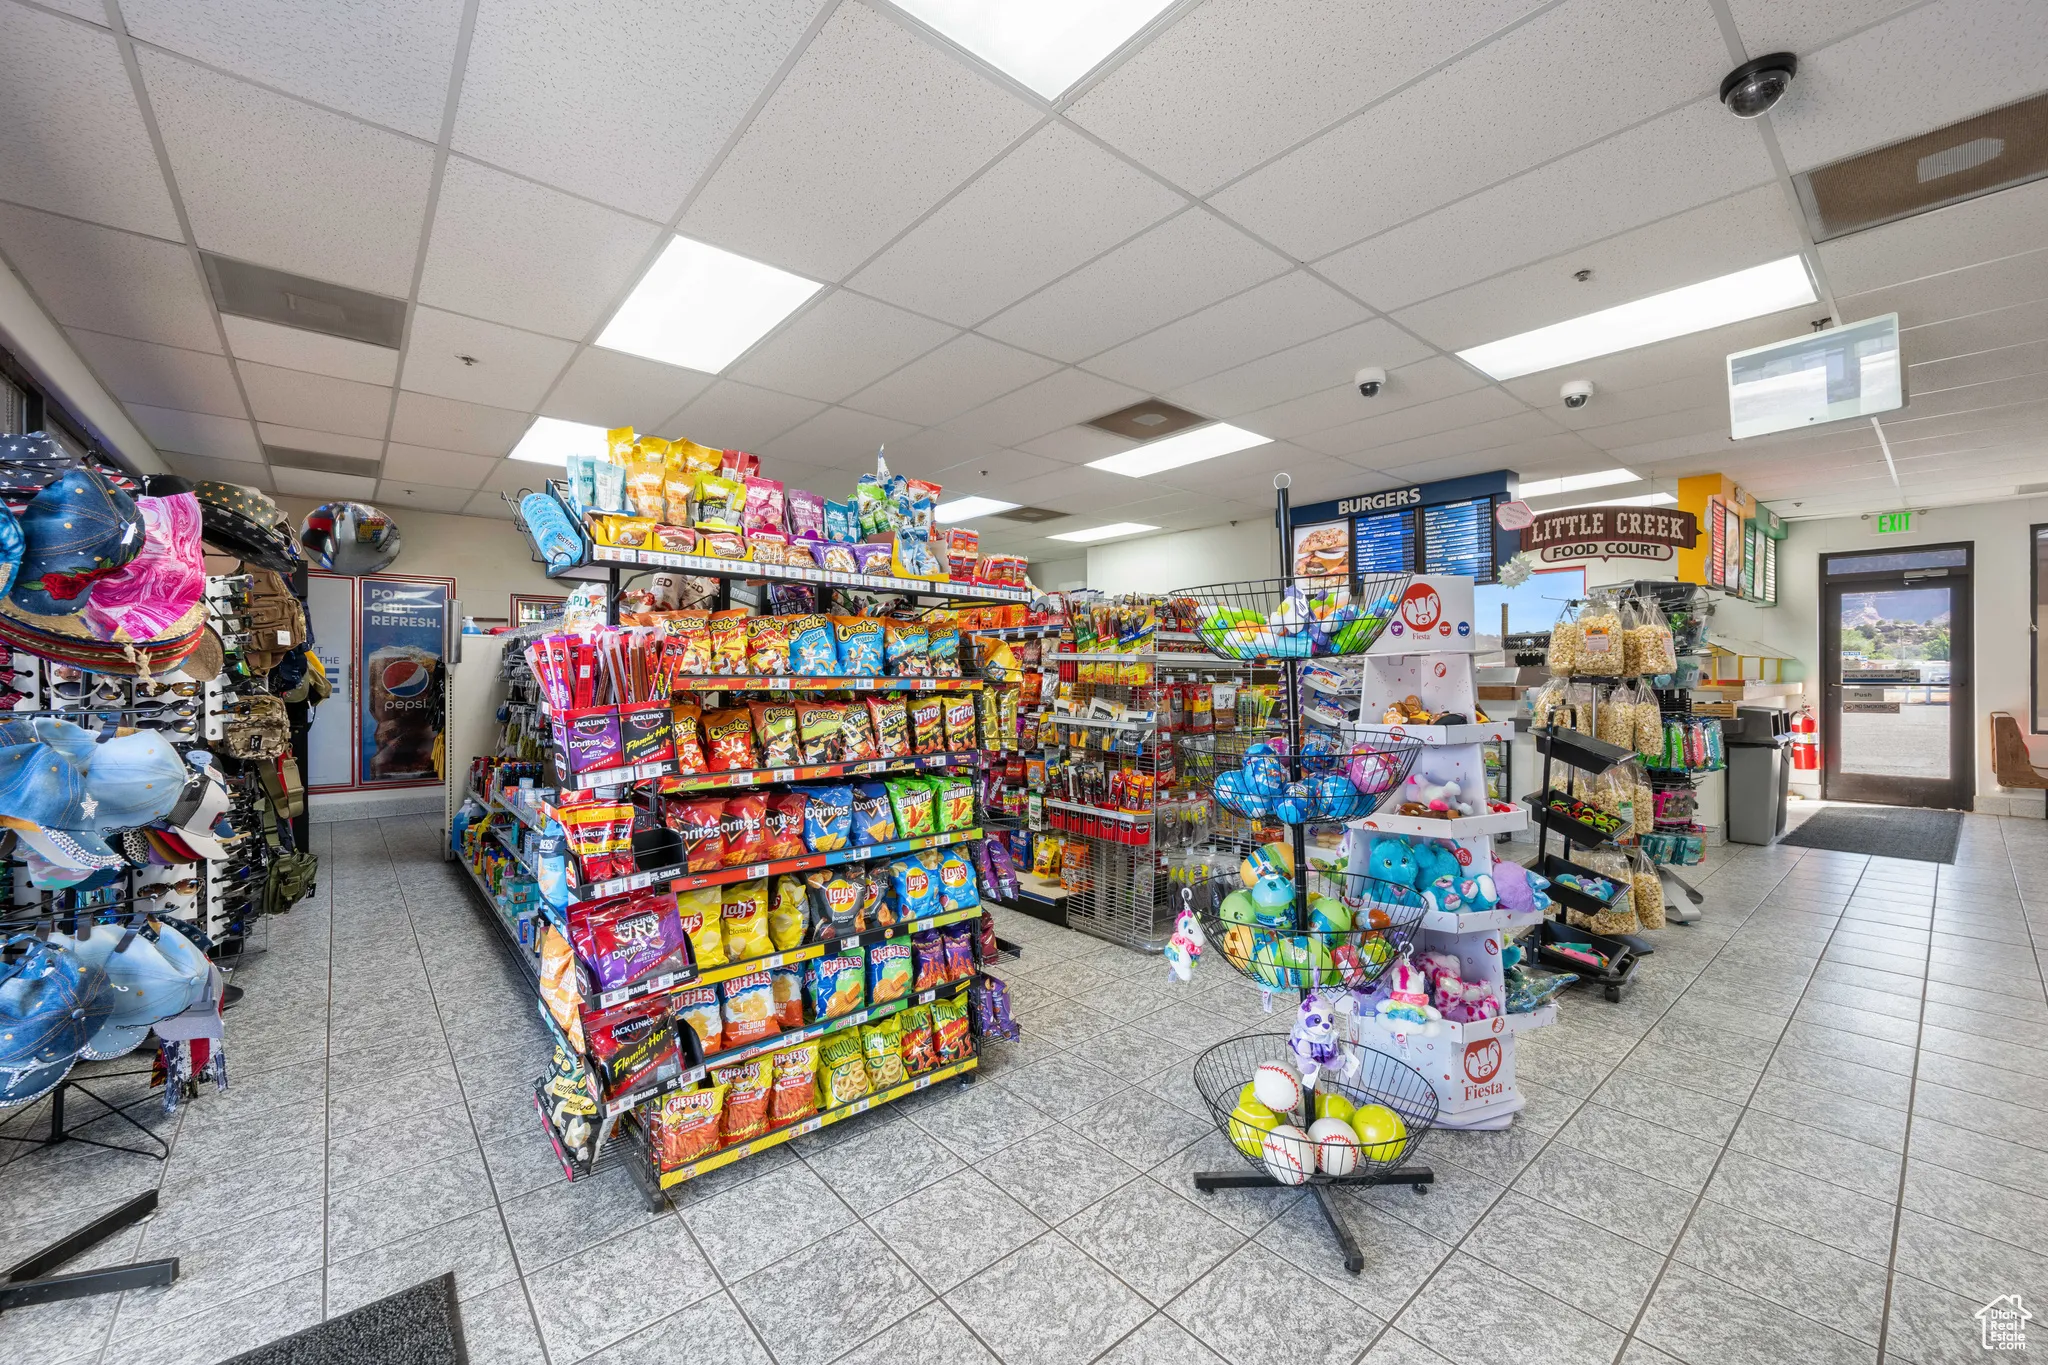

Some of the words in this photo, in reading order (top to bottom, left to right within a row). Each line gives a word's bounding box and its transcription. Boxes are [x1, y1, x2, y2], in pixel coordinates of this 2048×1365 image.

[1338, 487, 1421, 515] BURGERS
[1531, 512, 1604, 543] LITTLE
[1616, 511, 1685, 541] CREEK
[1877, 512, 1912, 533] EXIT
[1552, 542, 1598, 559] FOOD
[1604, 541, 1661, 557] COURT
[371, 615, 441, 628] REFRESH.
[663, 618, 704, 635] Cheetos
[711, 617, 738, 631] eetos
[747, 617, 784, 637] Cheetos
[788, 615, 827, 639] Cheetos
[838, 621, 879, 641] Cheetos
[894, 625, 925, 640] Cheetos
[1412, 632, 1431, 641] Fiesta
[318, 656, 340, 665] THE
[384, 699, 427, 711] pepsi
[573, 720, 591, 729] JACK
[590, 716, 610, 726] LINK'S
[630, 713, 647, 722] JACK
[646, 711, 664, 720] LINK'S
[802, 711, 840, 728] Cheetos
[878, 711, 907, 729] XXTRA
[914, 705, 941, 726] Fritos
[710, 718, 750, 741] Cheetos
[570, 738, 600, 749] Doritos
[625, 731, 656, 754] Flamin'
[655, 725, 671, 738] Hot
[640, 744, 660, 757] ORIGINAL
[594, 756, 614, 768] STICKS
[853, 794, 890, 814] Doritos
[899, 790, 932, 809] DINAMITA
[765, 812, 799, 827] oritos
[804, 804, 849, 819] Doritos
[720, 816, 761, 833] oritos
[659, 867, 681, 878] SNACK
[943, 863, 967, 881] Lay's
[906, 872, 929, 892] Lay's
[828, 885, 855, 904] Lay's
[722, 899, 755, 922] Lay's
[728, 927, 753, 936] Classic
[612, 943, 648, 961] Doritos
[870, 944, 911, 964] RUFFLES
[822, 956, 863, 977] RUFFLES
[723, 970, 772, 997] RUFFLES
[611, 1023, 631, 1039] JACK
[630, 1017, 655, 1032] LINK'S
[738, 1020, 767, 1031] CHEDDAR
[648, 1028, 667, 1047] Hot
[773, 1048, 810, 1066] HESTER'S
[717, 1061, 761, 1083] CHESTER'S
[1463, 1081, 1504, 1101] Fiesta
[665, 1091, 714, 1113] CHESTER'S
